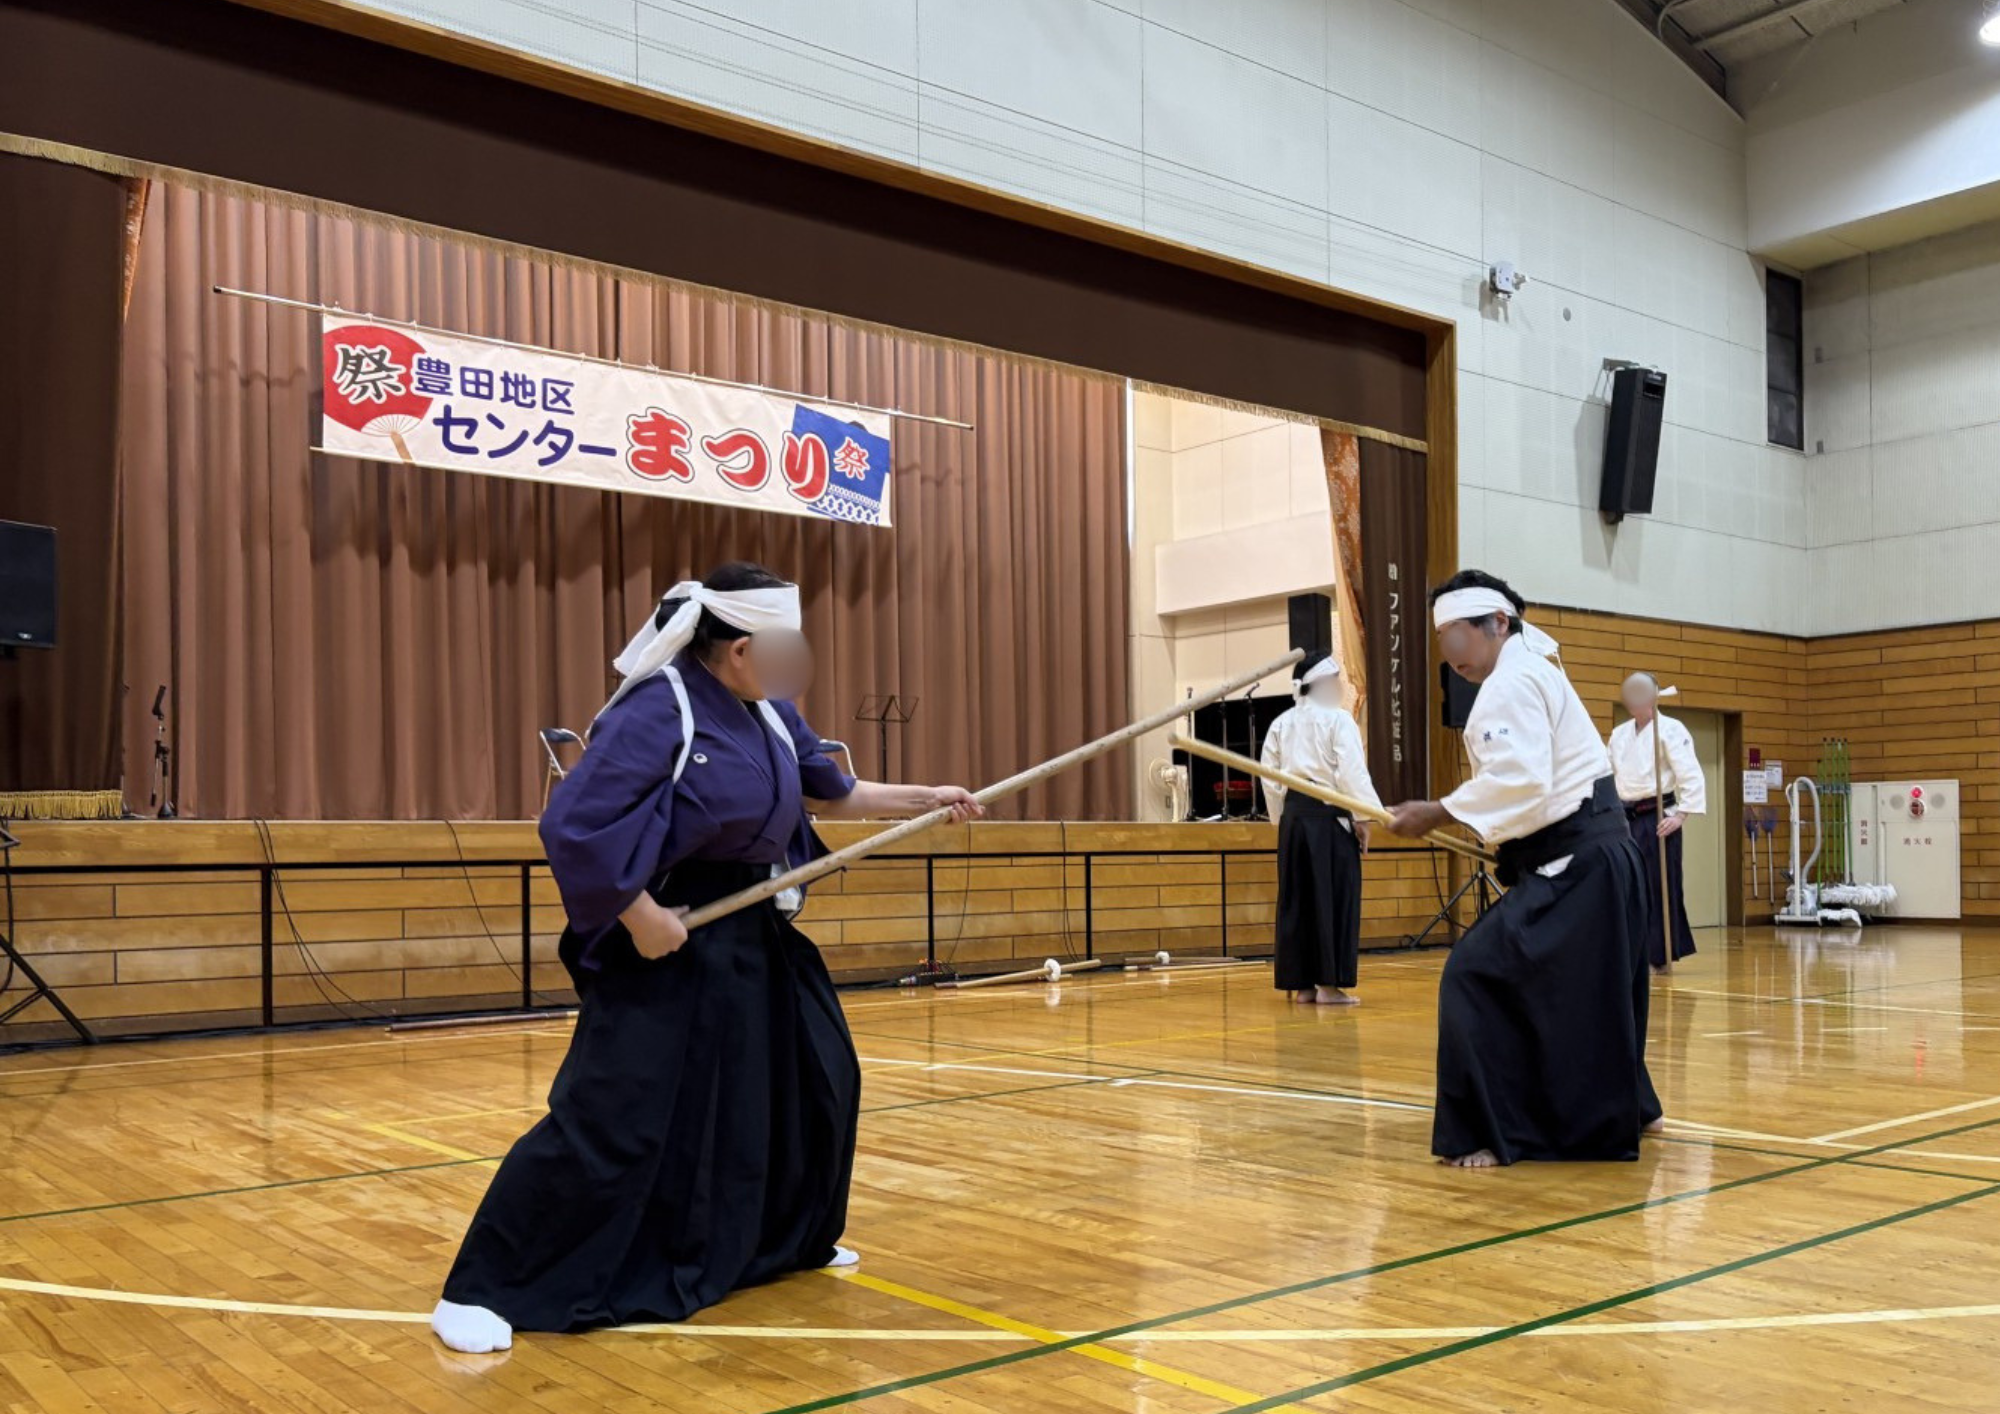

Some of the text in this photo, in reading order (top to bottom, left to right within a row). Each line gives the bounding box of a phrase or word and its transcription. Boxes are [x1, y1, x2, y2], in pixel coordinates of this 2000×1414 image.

[336, 345, 403, 402] 祭
[415, 356, 575, 415] 豊田地区
[432, 404, 618, 467] センター
[627, 408, 828, 502] まつり
[834, 437, 870, 480] 祭
